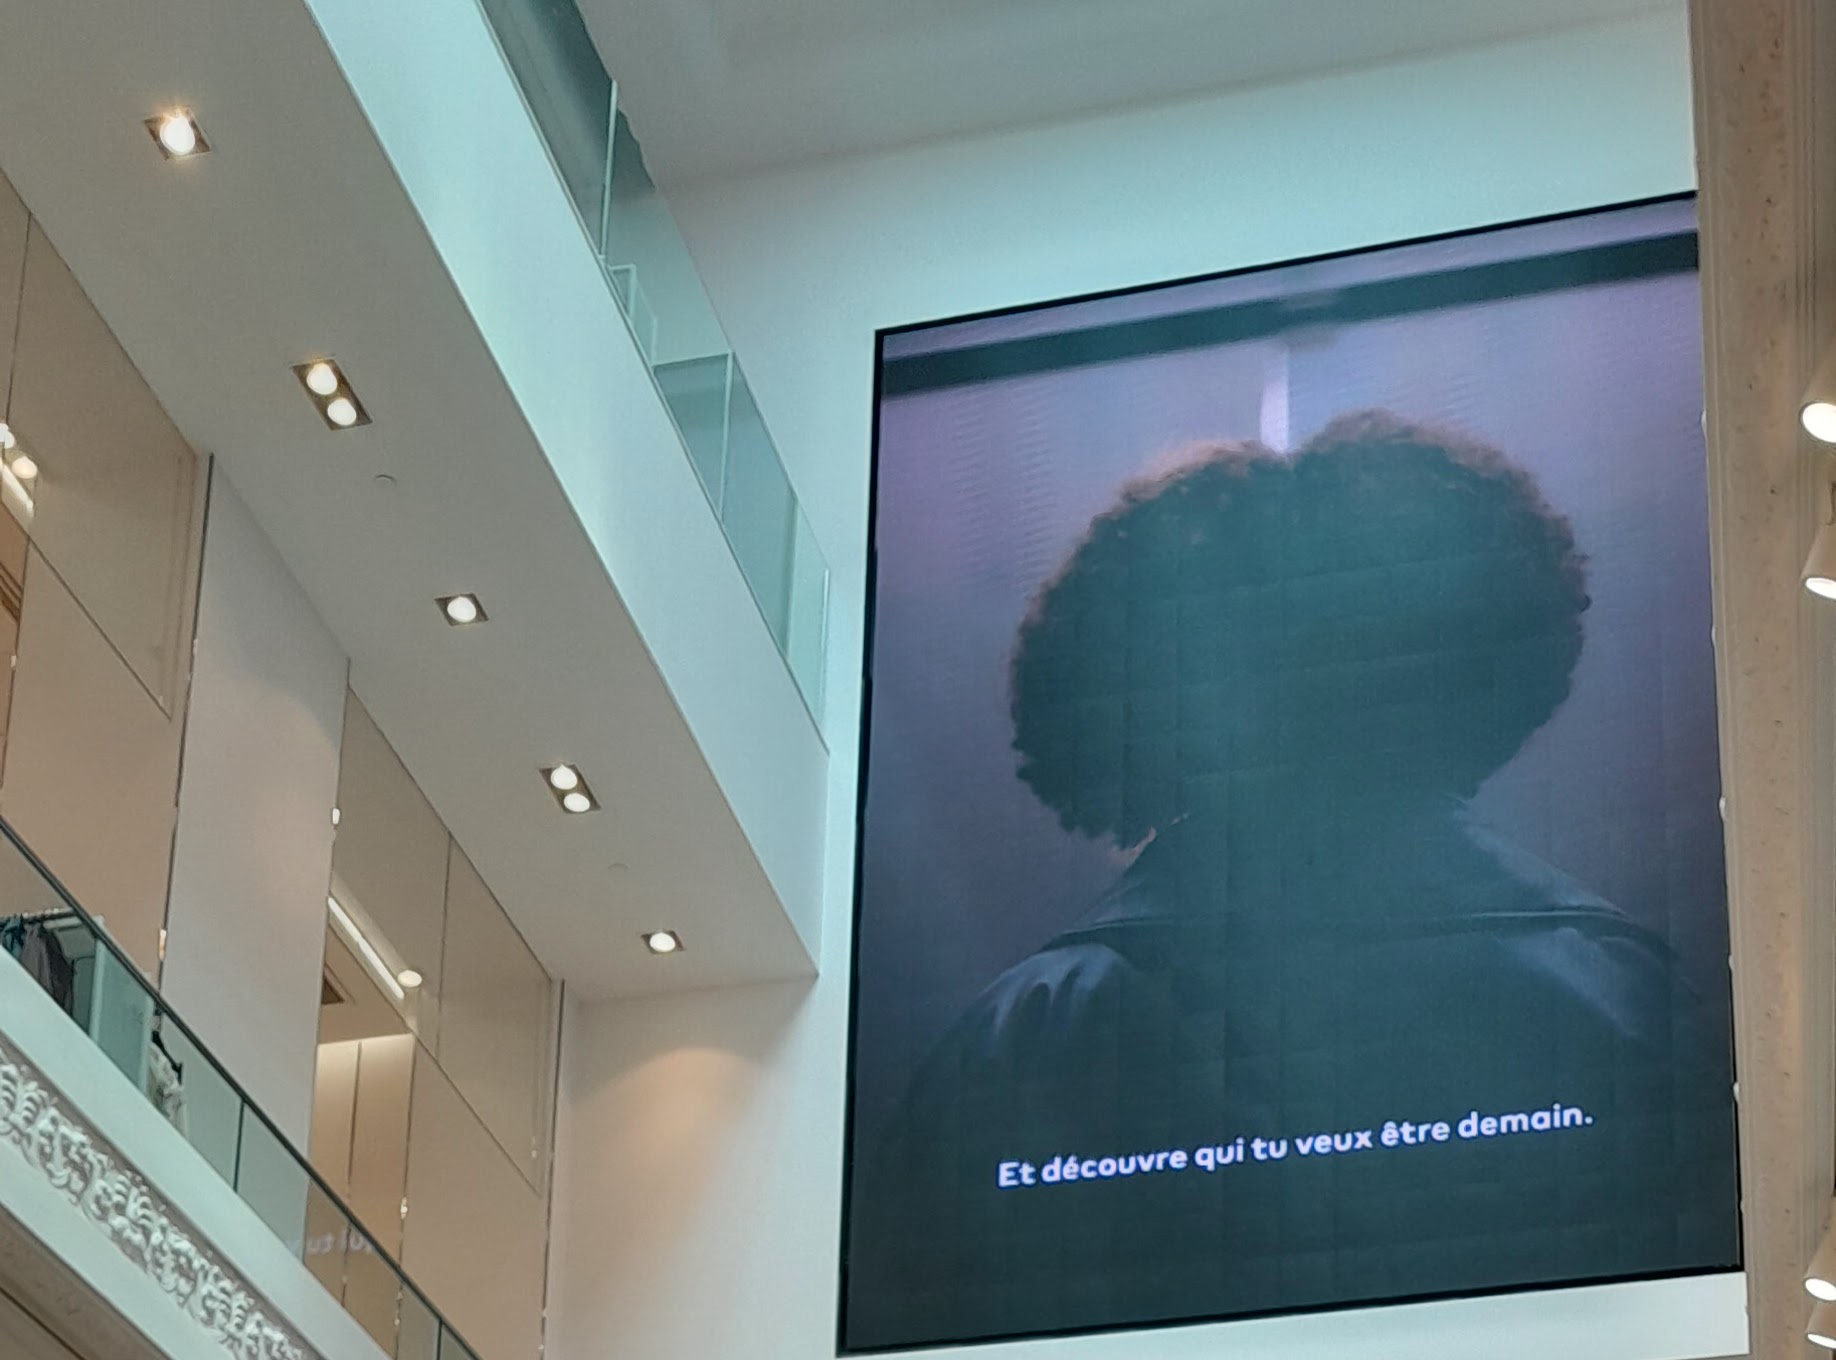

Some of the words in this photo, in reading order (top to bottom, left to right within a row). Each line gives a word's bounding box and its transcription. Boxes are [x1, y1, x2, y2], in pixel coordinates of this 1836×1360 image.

[998, 1160, 1036, 1187] Et
[1041, 1149, 1188, 1183] découvre
[1195, 1137, 1244, 1171] qui
[1251, 1137, 1288, 1160] tu
[1295, 1130, 1373, 1155] veux
[1380, 1121, 1451, 1146] être
[1457, 1103, 1593, 1138] demain.
